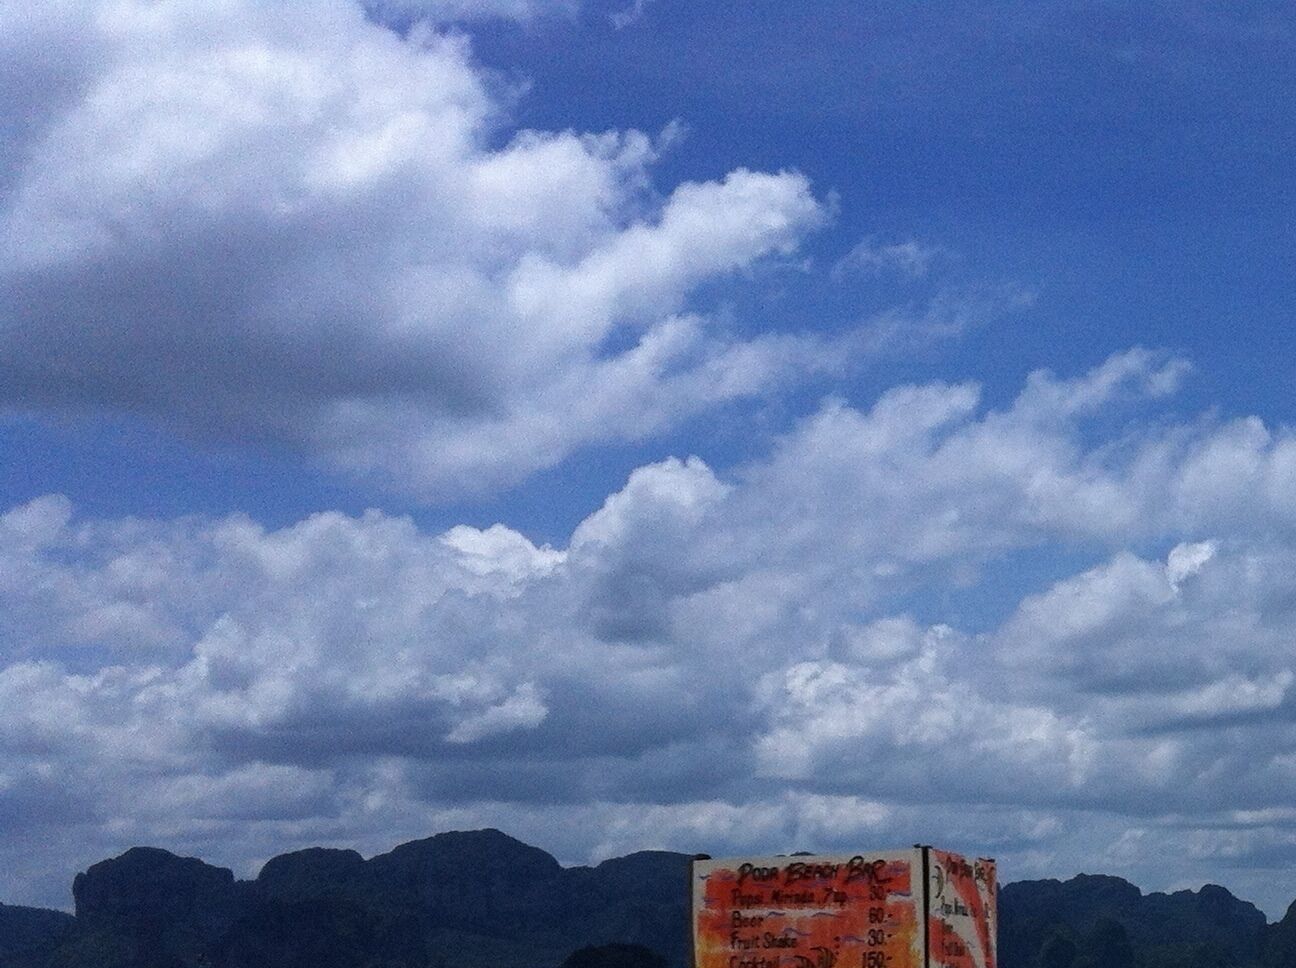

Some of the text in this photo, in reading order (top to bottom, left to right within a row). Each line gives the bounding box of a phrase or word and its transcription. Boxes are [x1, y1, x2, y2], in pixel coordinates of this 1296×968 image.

[732, 911, 764, 928] Beer
[730, 931, 760, 949] Fruit
[763, 932, 798, 949] Shake
